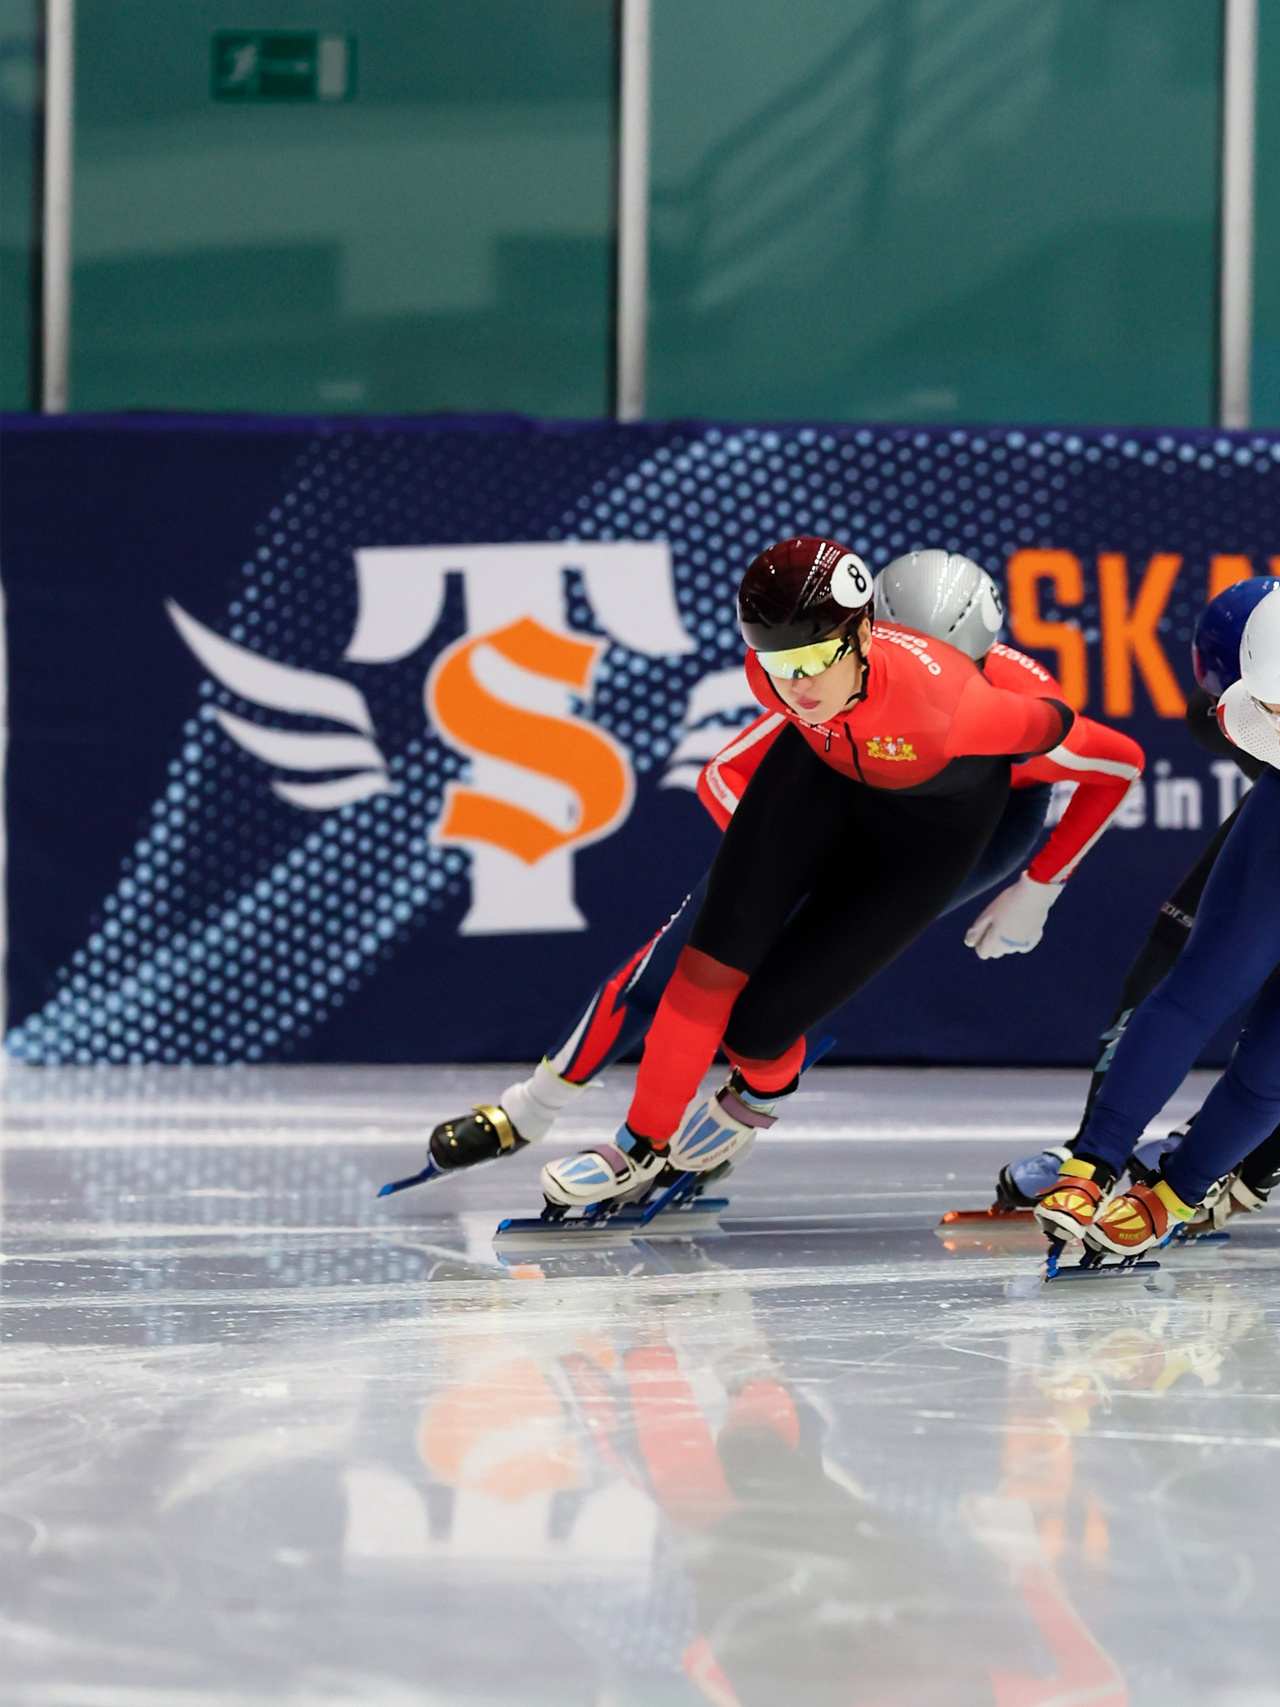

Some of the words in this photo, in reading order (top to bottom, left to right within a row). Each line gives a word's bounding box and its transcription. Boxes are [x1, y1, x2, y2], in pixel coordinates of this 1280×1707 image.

[846, 562, 868, 594] 8
[871, 630, 942, 676] СВЕРДЛ
[1153, 758, 1203, 830] in
